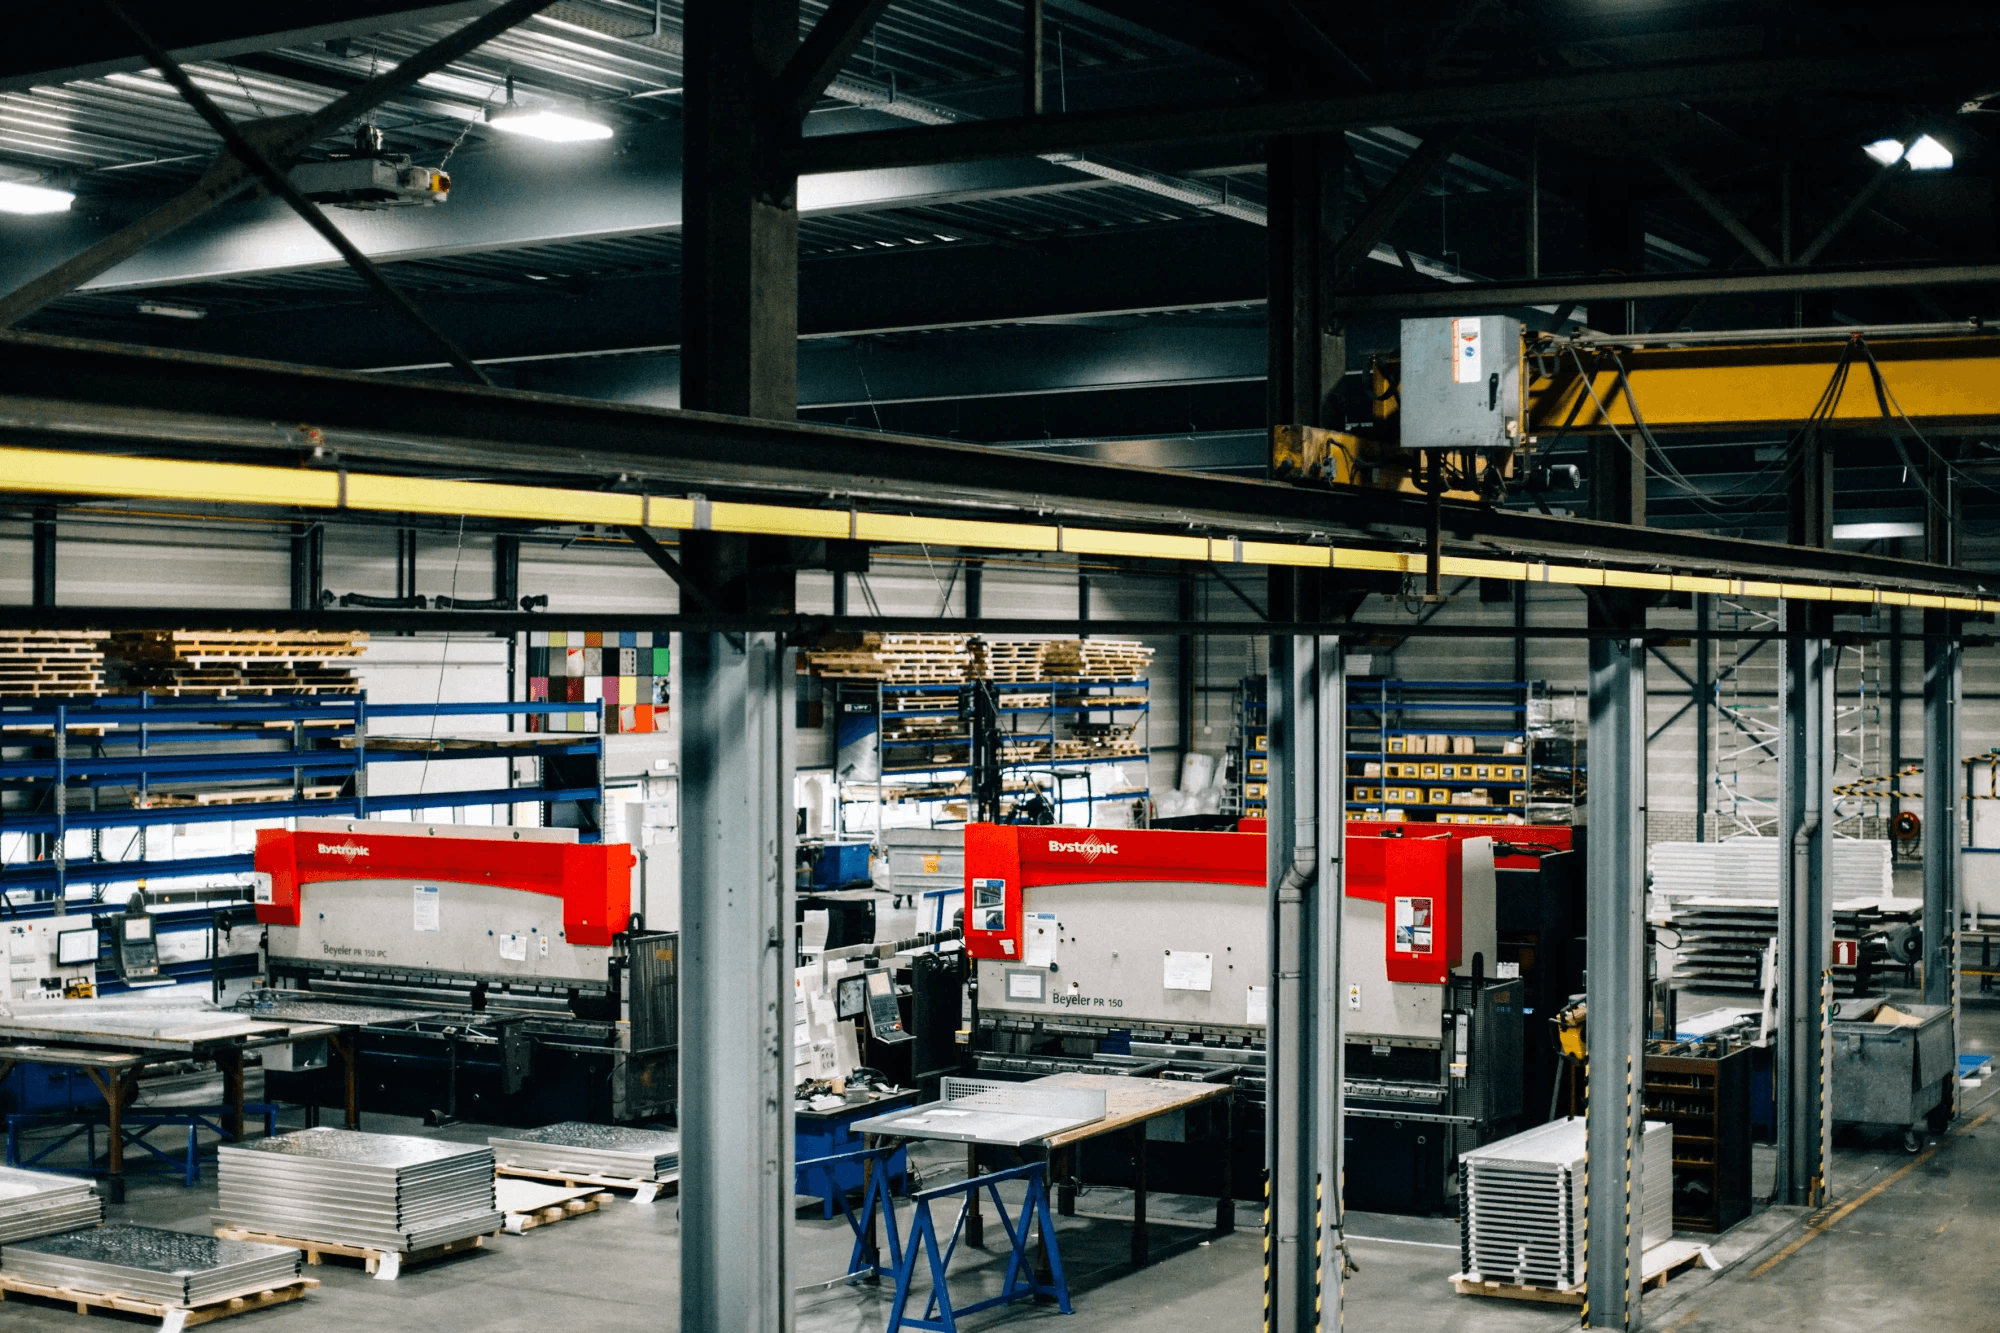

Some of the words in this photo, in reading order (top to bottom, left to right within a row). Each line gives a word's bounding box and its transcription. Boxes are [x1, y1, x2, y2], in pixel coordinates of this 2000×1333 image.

[318, 843, 370, 856] Bystronic
[1048, 840, 1119, 854] Bystronic
[323, 944, 351, 957] Beyeler
[364, 949, 376, 957] 150
[1053, 993, 1091, 1008] Beyeler
[1093, 997, 1105, 1006] PR
[1108, 998, 1123, 1008] 150
